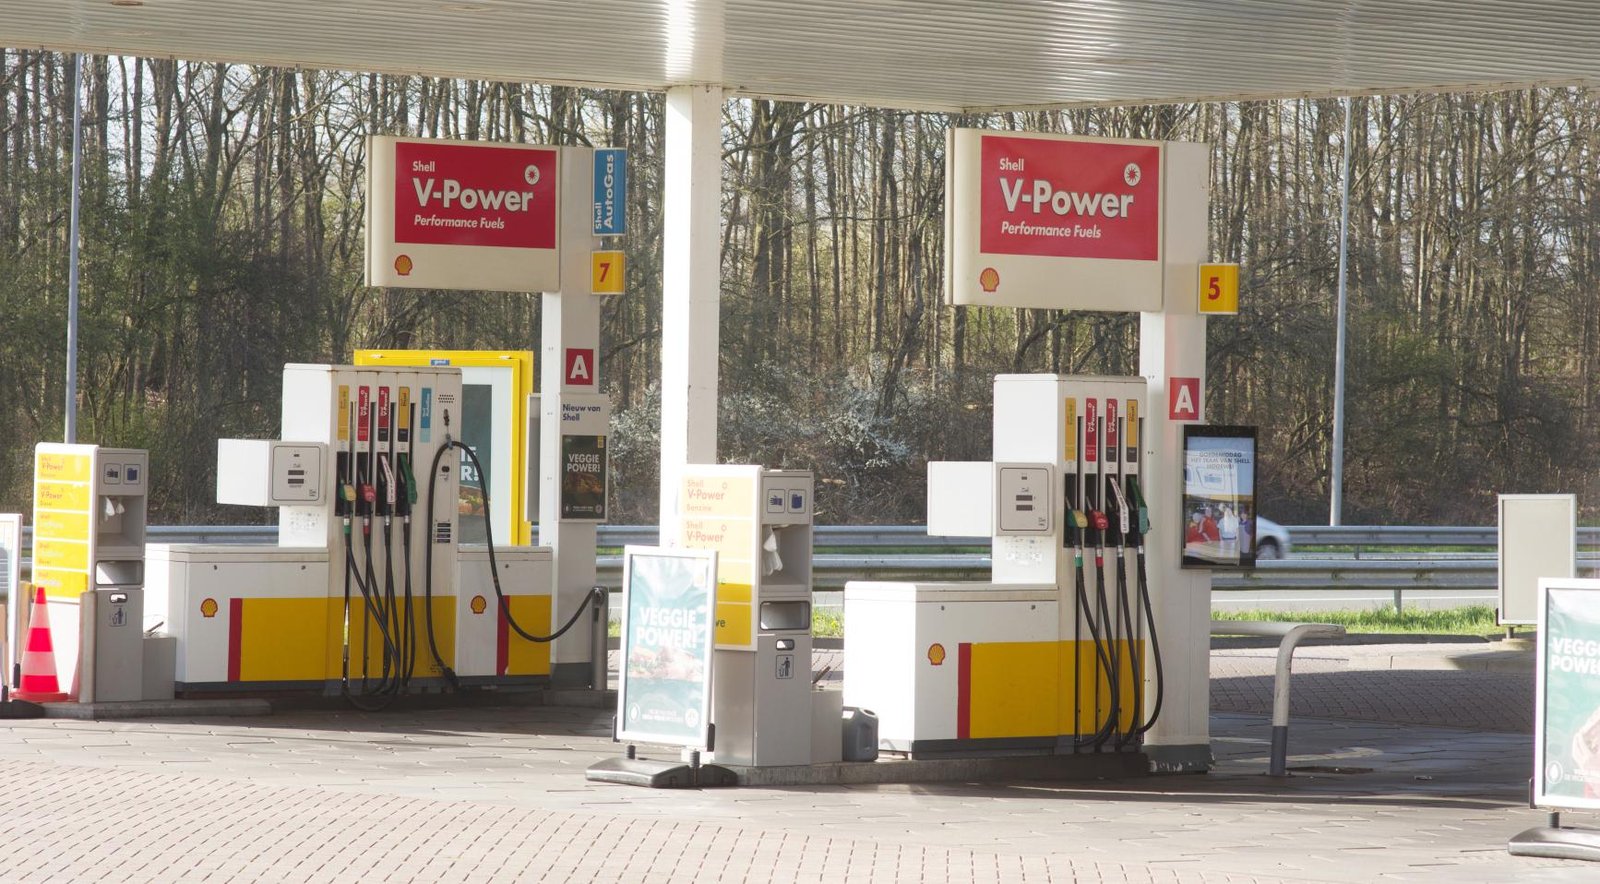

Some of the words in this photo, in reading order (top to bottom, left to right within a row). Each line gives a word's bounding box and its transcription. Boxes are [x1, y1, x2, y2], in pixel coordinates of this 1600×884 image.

[412, 161, 435, 172] Shell
[1000, 158, 1024, 171] Shell
[412, 177, 533, 212] V-Power
[603, 154, 614, 229] AutoGas
[1000, 177, 1134, 218] V-Power
[414, 214, 478, 228] Performance
[480, 216, 505, 229] Fuels
[1001, 221, 1071, 237] Performance
[1073, 224, 1102, 239] Fuels
[599, 263, 611, 282] 7
[1208, 277, 1220, 300] 5
[570, 354, 589, 379] A
[1174, 384, 1195, 413] A
[562, 404, 586, 412] Nieuw
[562, 413, 580, 421] Shell
[568, 453, 600, 463] VEGGIE
[566, 463, 601, 472] POWER!
[687, 479, 704, 488] Shell
[687, 488, 725, 501] V-Power
[686, 520, 703, 529] Shell
[686, 530, 724, 543] V-Power
[639, 607, 697, 626] VEGGIE
[636, 626, 697, 649] POWER!
